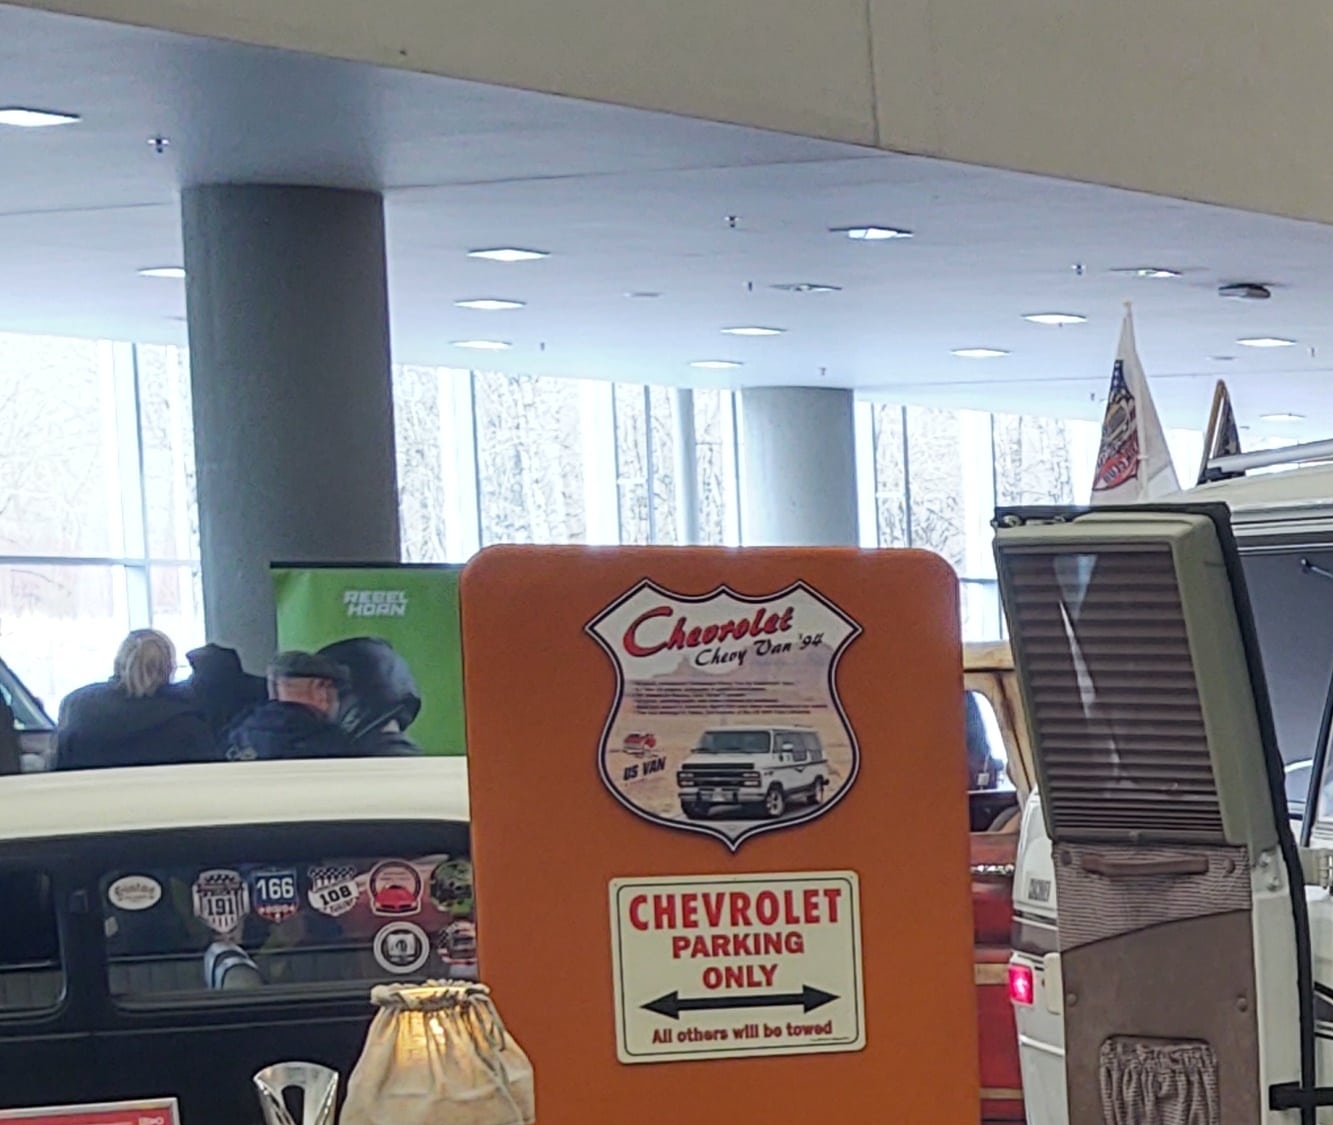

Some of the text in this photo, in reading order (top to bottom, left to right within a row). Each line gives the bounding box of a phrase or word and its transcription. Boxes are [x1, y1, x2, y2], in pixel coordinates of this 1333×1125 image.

[344, 591, 408, 604] REBEL
[348, 603, 406, 616] HORN
[623, 606, 795, 657] Chevrolet
[695, 646, 746, 666] Chevy
[753, 639, 792, 656] Van
[623, 756, 666, 781] US VAN
[256, 878, 294, 899] 166
[207, 898, 235, 916] 191
[628, 888, 843, 930] CHEVROLET
[672, 932, 805, 959] PARKING
[702, 963, 779, 989] ONLY
[652, 1020, 832, 1044] All others will be towed
